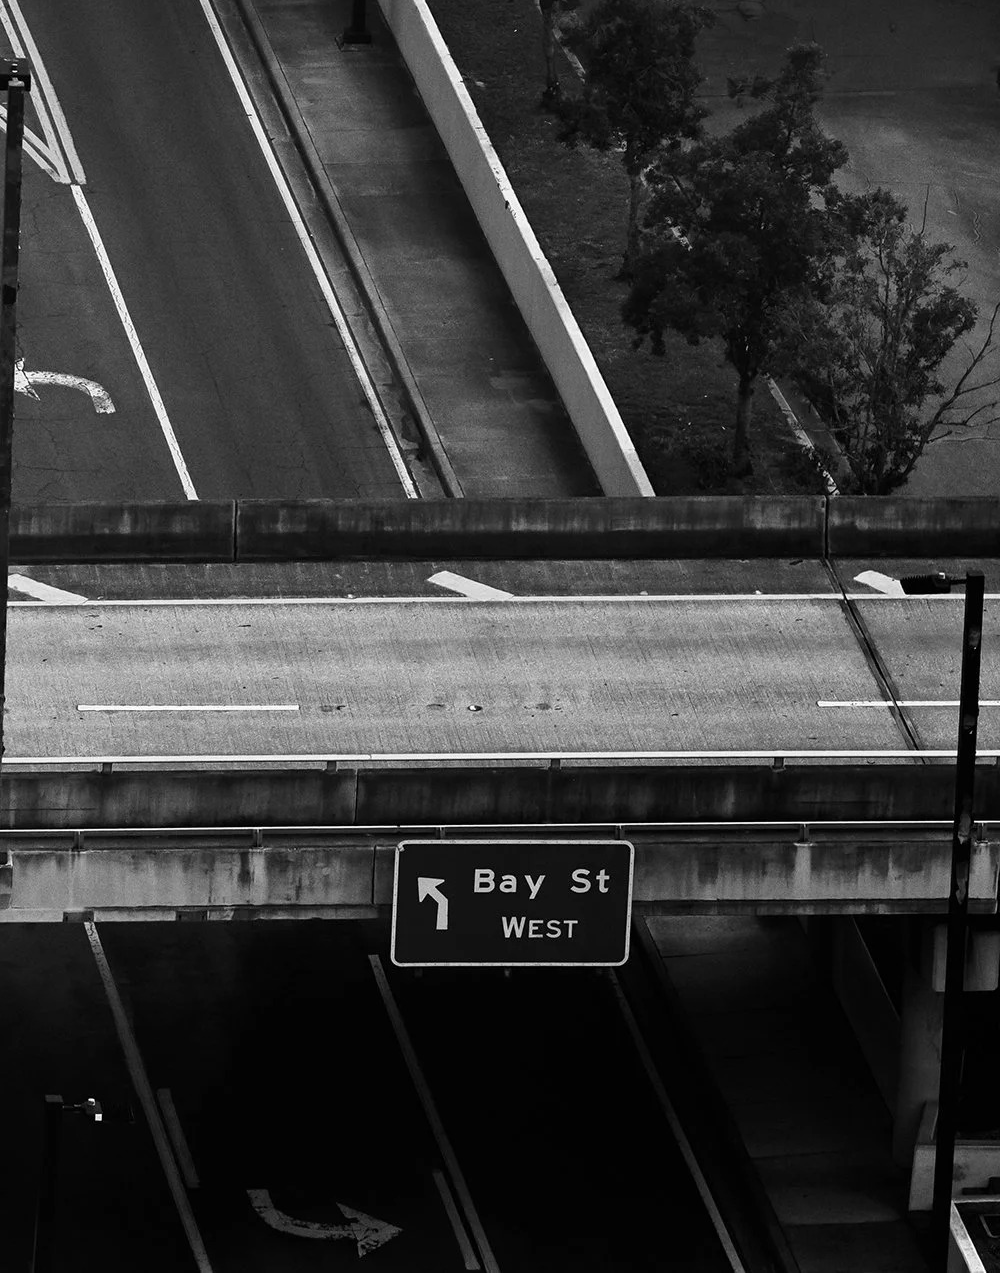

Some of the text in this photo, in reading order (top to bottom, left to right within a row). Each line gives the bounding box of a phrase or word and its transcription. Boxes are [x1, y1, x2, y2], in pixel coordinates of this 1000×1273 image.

[473, 868, 611, 900] Bay St
[501, 916, 579, 939] WEST
